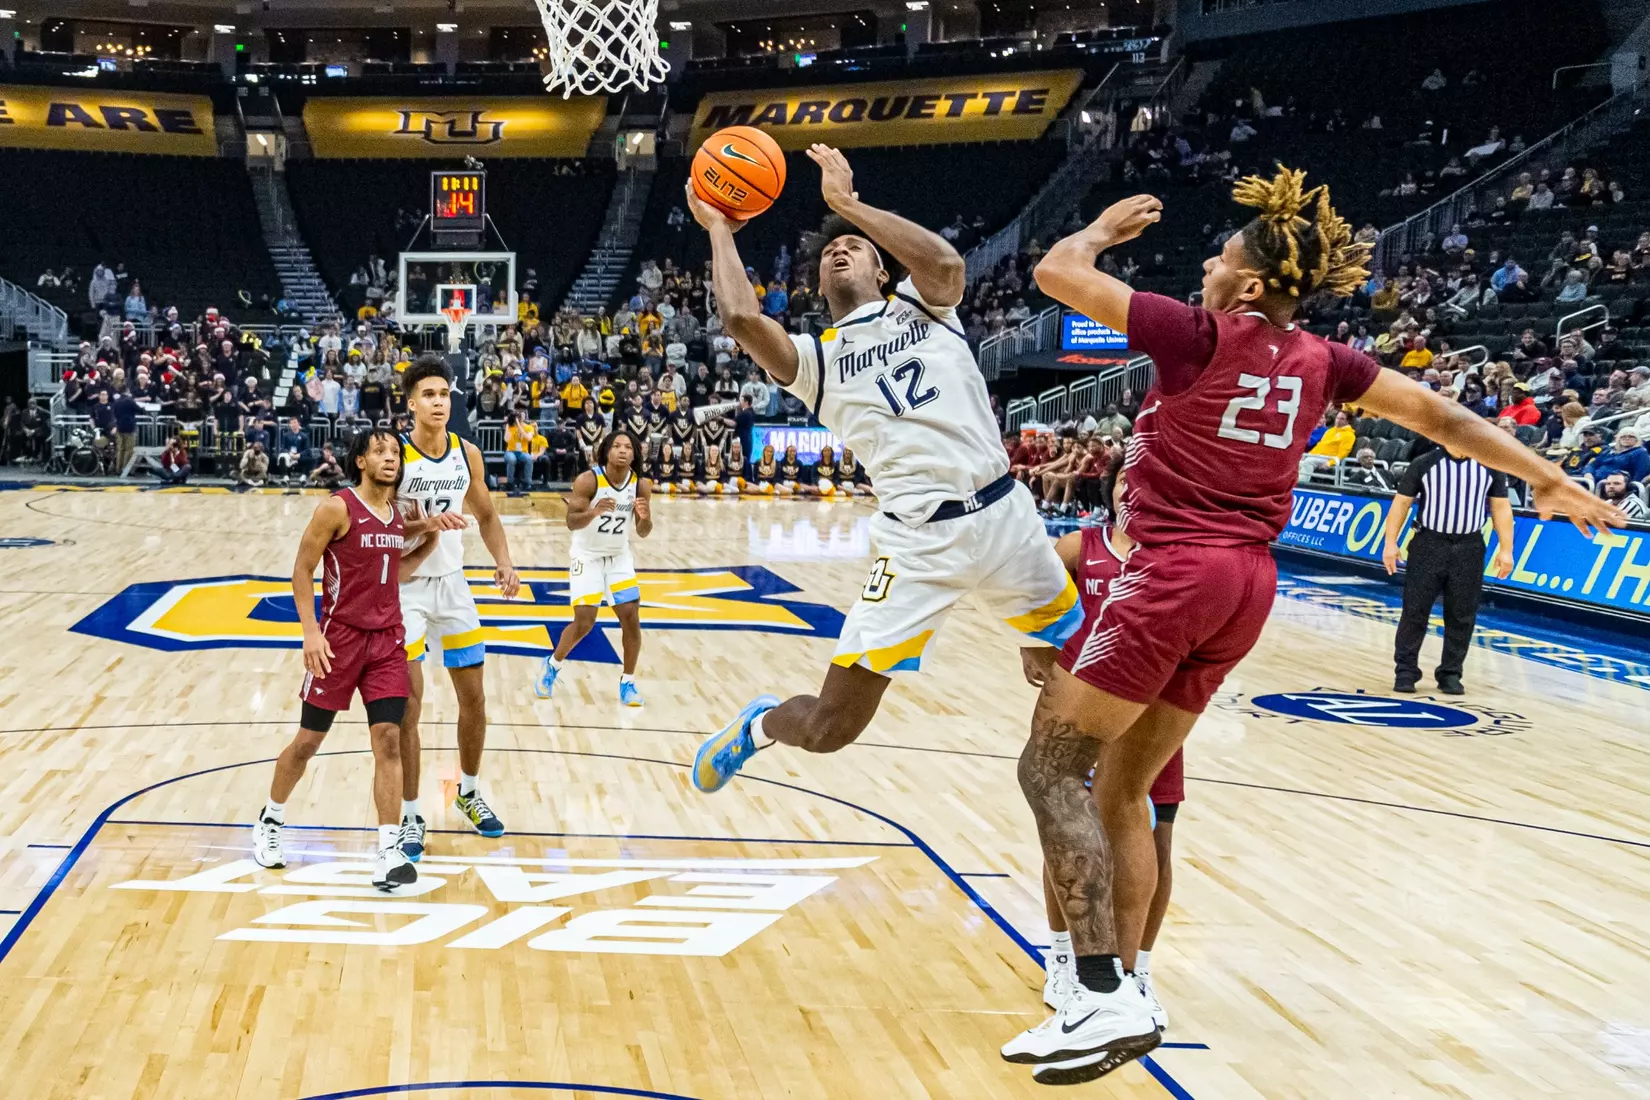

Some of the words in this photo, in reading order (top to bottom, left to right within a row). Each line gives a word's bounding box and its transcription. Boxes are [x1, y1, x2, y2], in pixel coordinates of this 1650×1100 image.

[46, 102, 204, 135] ARE
[702, 89, 1050, 129] MARQUETTE
[392, 109, 505, 145] MU
[450, 192, 474, 214] 14
[833, 319, 931, 384] Marquette
[875, 357, 940, 417] 12
[1217, 372, 1302, 449] 23
[361, 533, 374, 548] NC
[597, 515, 626, 535] 22
[1282, 530, 1310, 545] OFFICES
[1310, 535, 1325, 547] LLC
[380, 553, 390, 585] 1
[1085, 578, 1104, 595] NC
[107, 858, 840, 911] EAST
[214, 899, 784, 957] BIG
